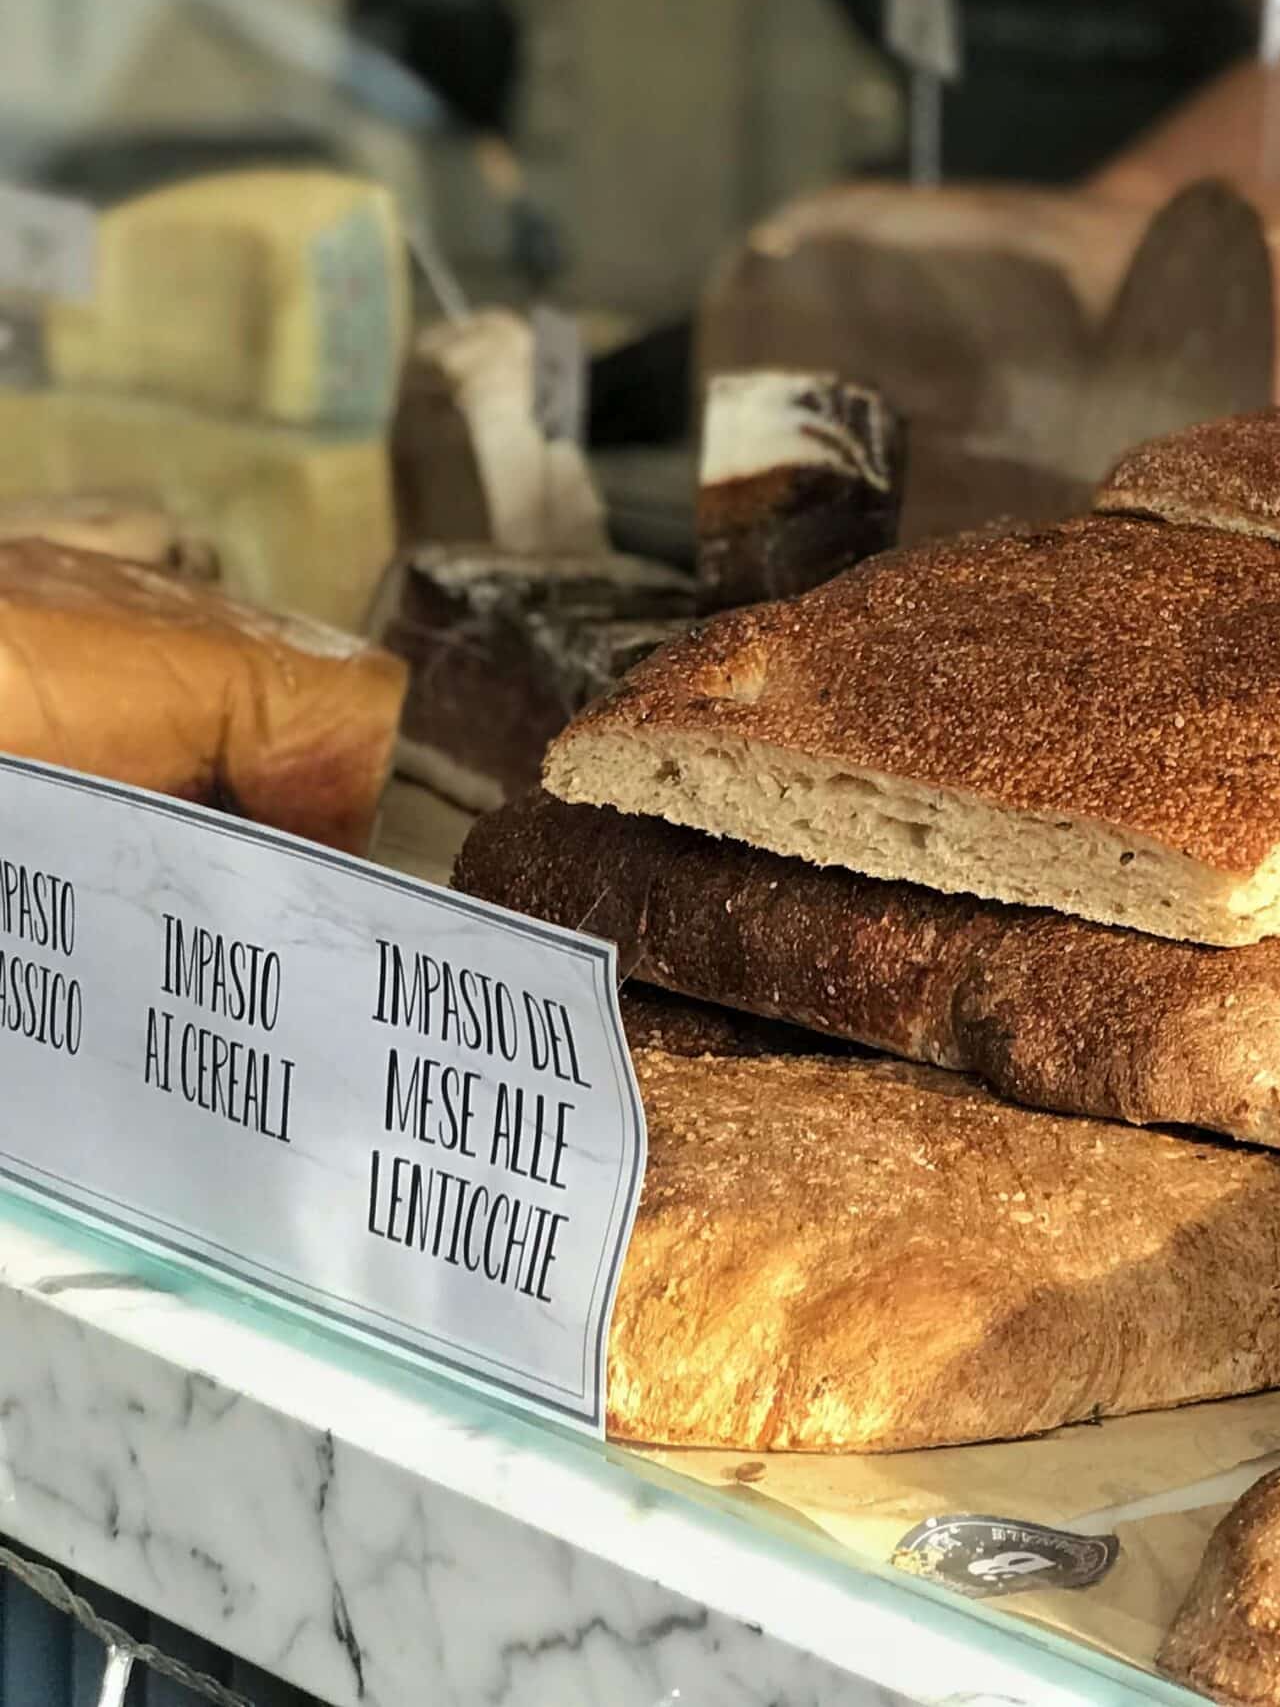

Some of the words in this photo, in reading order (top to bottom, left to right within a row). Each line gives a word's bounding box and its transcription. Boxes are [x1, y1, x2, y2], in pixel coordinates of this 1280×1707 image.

[160, 913, 281, 1032] IMPASTO
[371, 939, 518, 1063] IMPASTO
[522, 989, 592, 1089] DEL
[144, 1007, 173, 1093] AI
[180, 1022, 296, 1144] CEREALI
[384, 1048, 482, 1158] MESE
[489, 1081, 576, 1190] ALLE
[368, 1149, 570, 1303] LENTICCHIE
